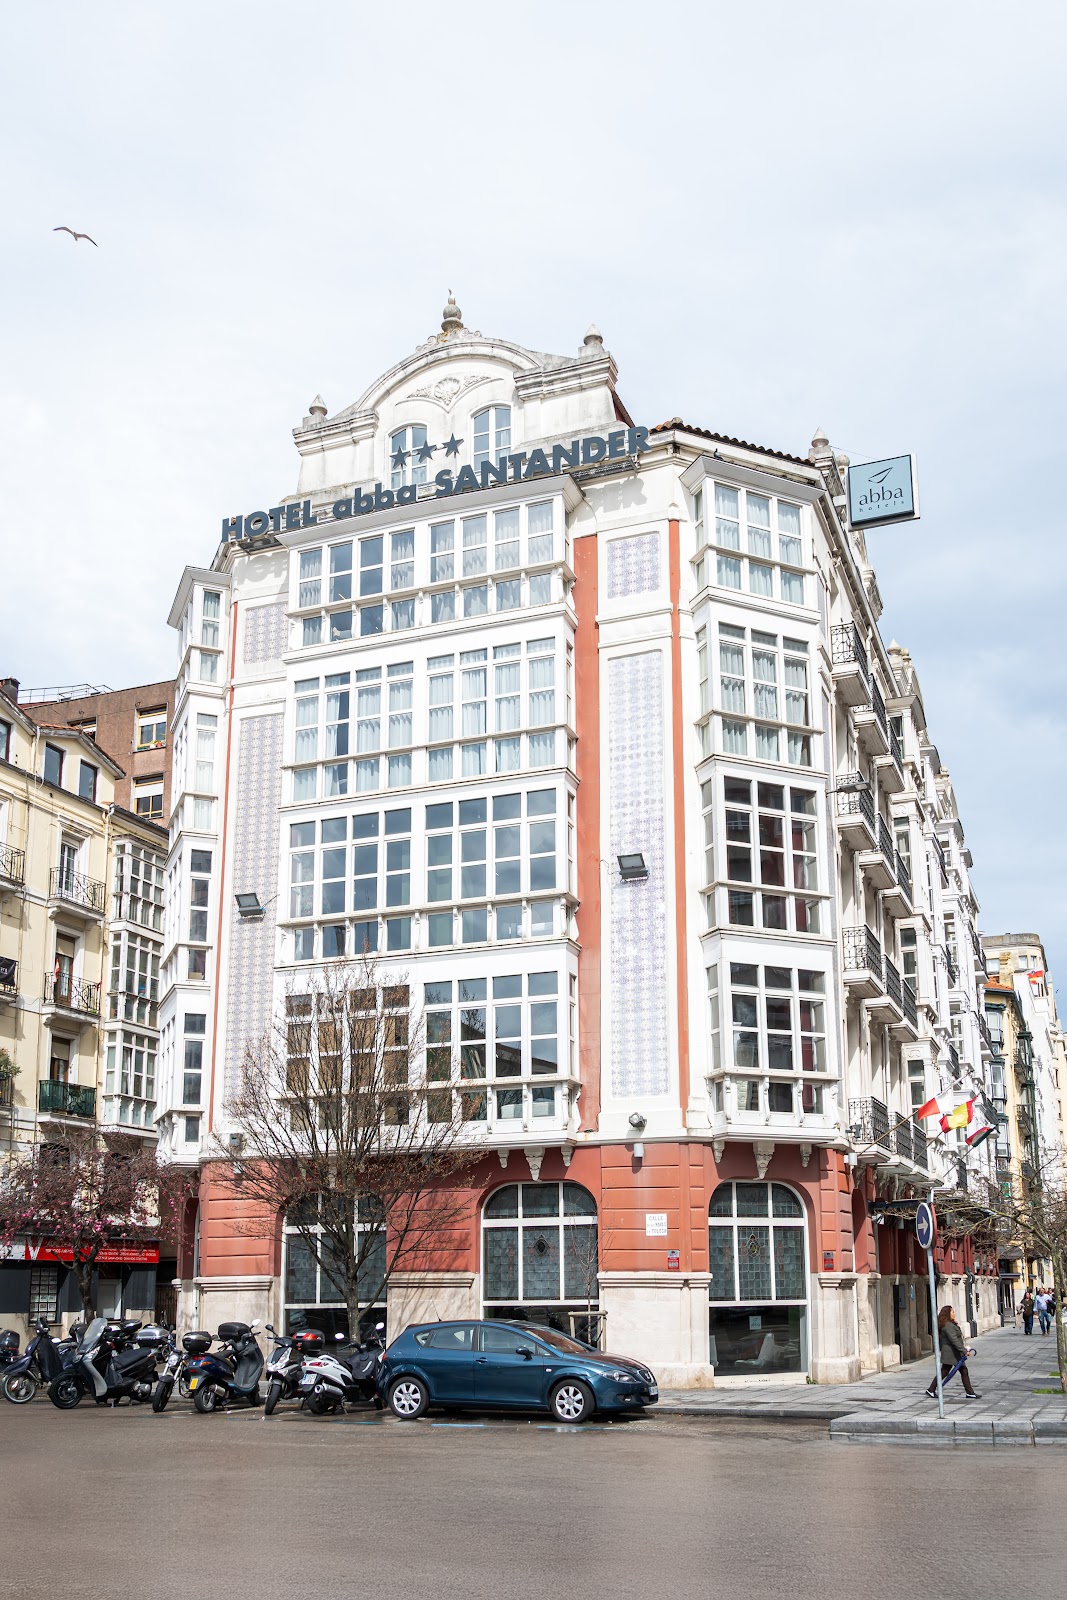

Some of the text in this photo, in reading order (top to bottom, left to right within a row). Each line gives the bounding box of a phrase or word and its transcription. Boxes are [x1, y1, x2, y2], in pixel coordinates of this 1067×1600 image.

[221, 425, 651, 543] HOTEL abba SANTANDER
[859, 486, 904, 506] abba
[859, 500, 905, 512] hotels
